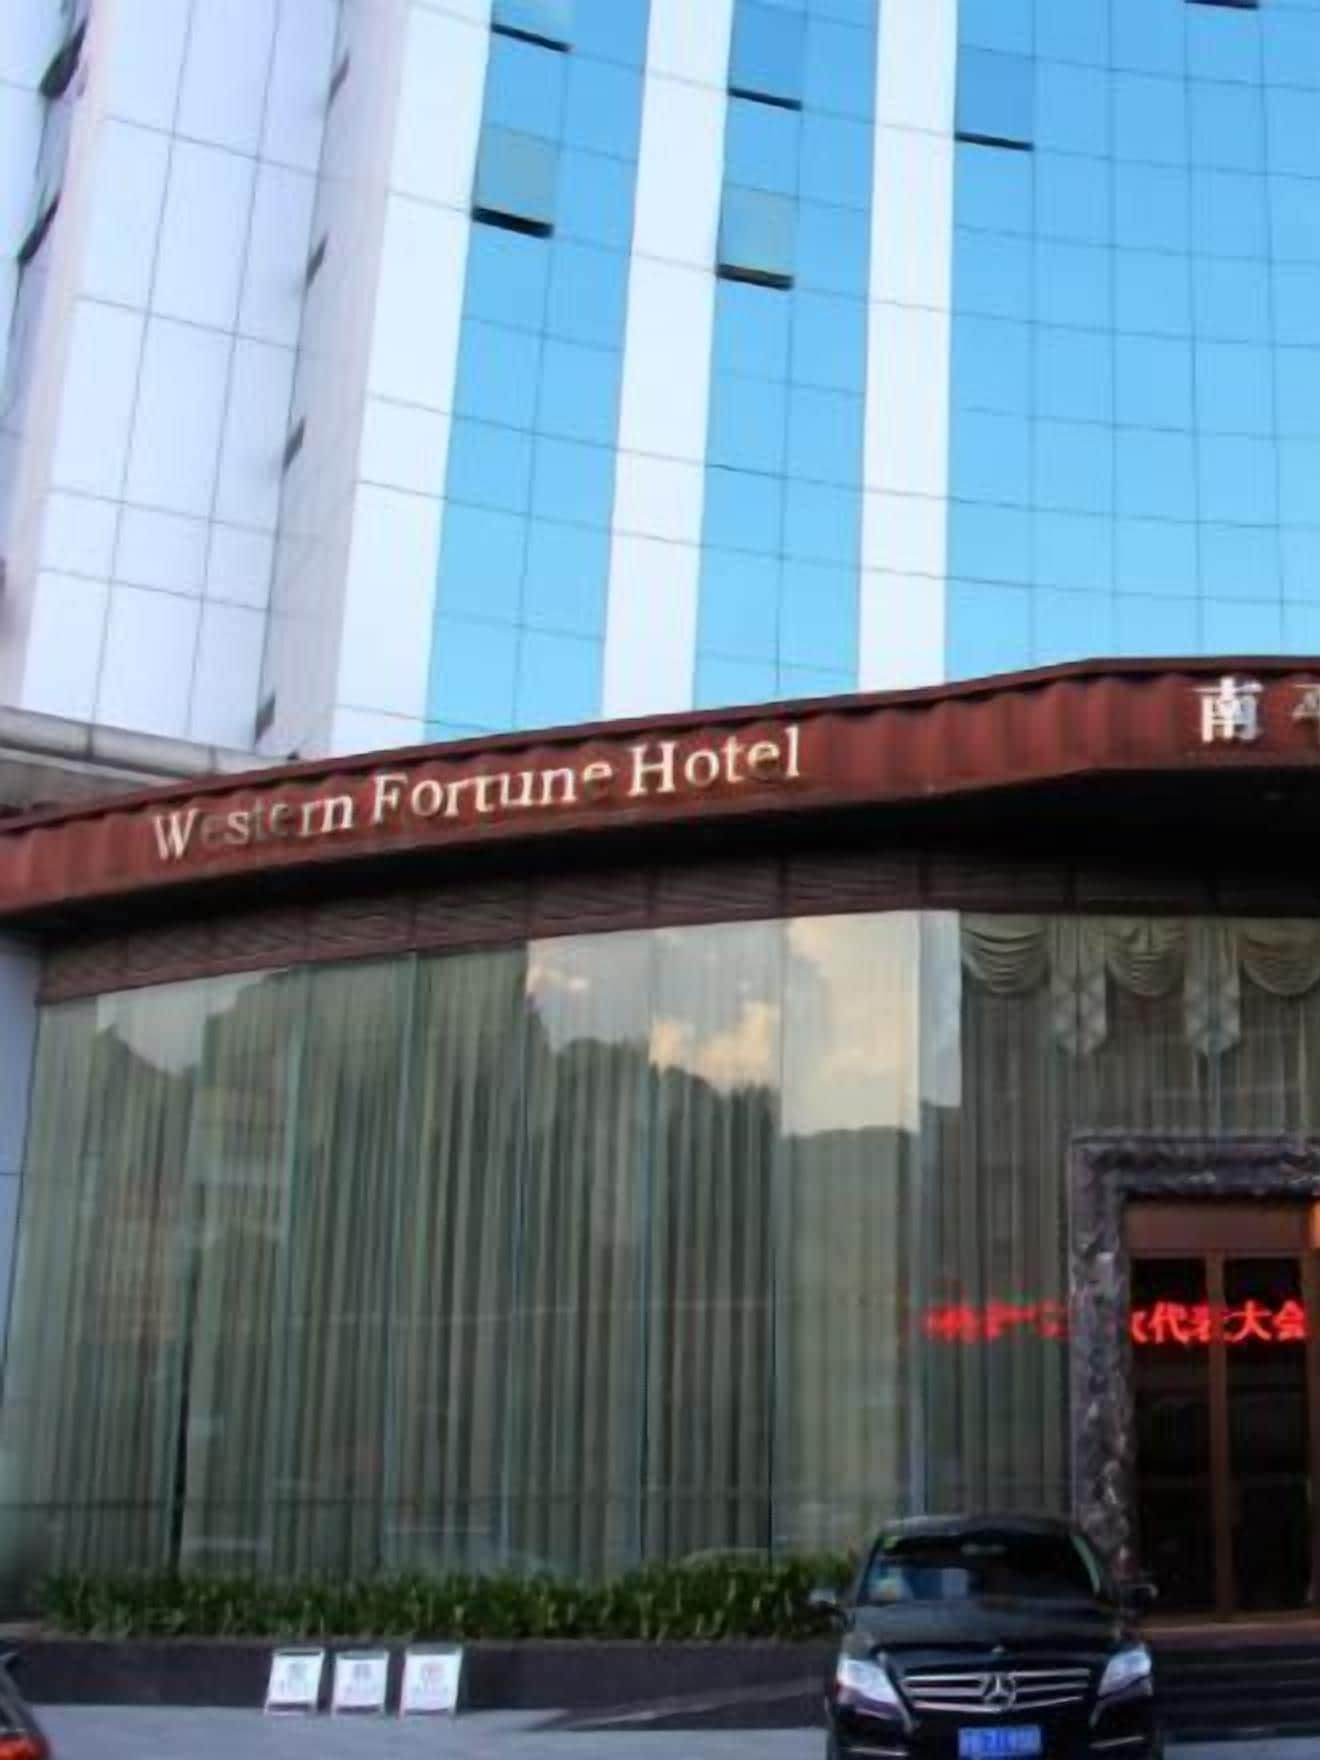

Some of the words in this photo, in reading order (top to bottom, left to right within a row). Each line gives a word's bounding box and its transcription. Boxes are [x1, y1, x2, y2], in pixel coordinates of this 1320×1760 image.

[153, 793, 354, 862] Western
[369, 759, 614, 825] Fortune
[627, 725, 801, 797] Hotel
